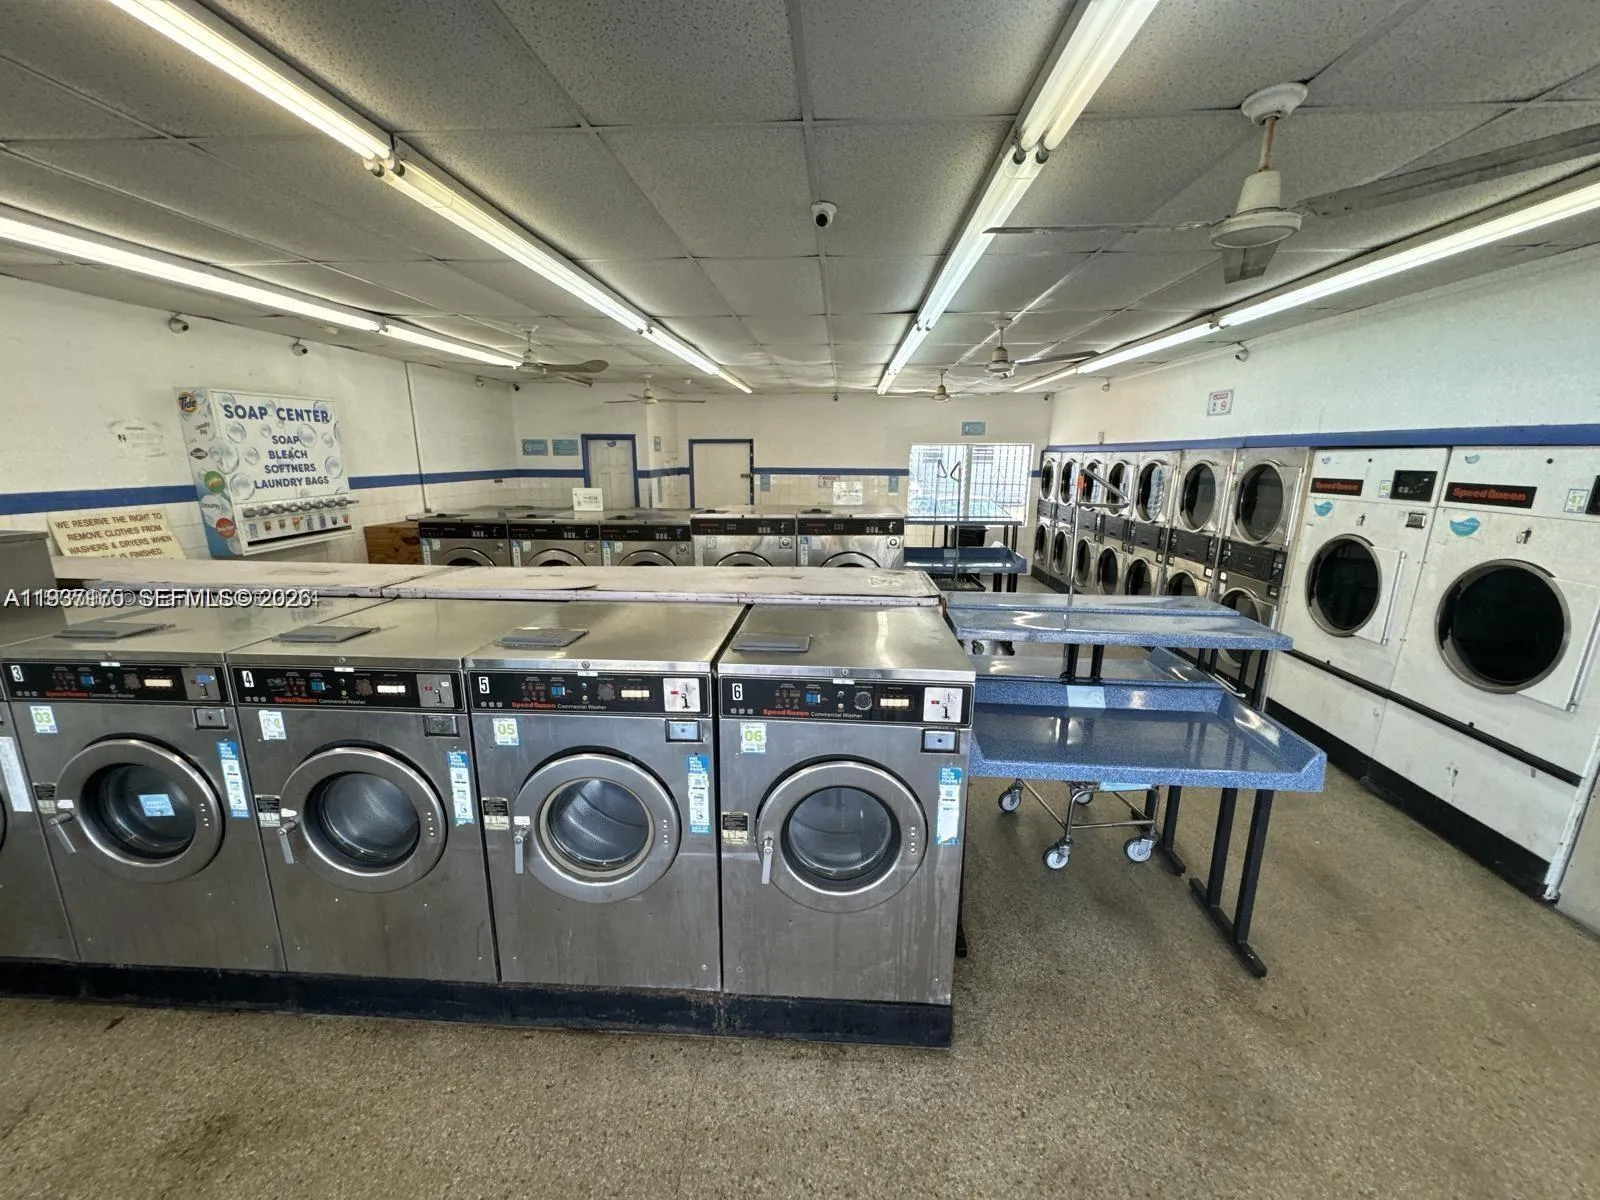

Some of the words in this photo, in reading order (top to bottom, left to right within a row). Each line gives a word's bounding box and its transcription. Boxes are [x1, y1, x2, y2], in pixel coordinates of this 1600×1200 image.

[223, 404, 268, 420] SOAP
[276, 407, 330, 423] CENTER
[271, 435, 300, 445] SOAP
[268, 449, 308, 460] BLEACH
[264, 463, 317, 474] SOFTNERS
[254, 478, 303, 490] LAUNDRY
[305, 475, 330, 486] BAGS
[1453, 487, 1487, 498] Speed
[1488, 488, 1527, 501] Queen
[54, 520, 70, 529] WE
[72, 517, 110, 528] RESERVE
[111, 515, 128, 524] THE
[128, 513, 151, 523] RIGHT
[152, 512, 162, 520] TO
[67, 531, 103, 542] REMOVE
[104, 526, 140, 538] CLOTHES
[141, 524, 162, 533] FROM
[67, 542, 109, 555] WASHERS
[111, 542, 117, 550] &
[119, 538, 150, 549] DRYERS
[150, 535, 172, 545] WHEN
[129, 548, 162, 559] FINISHED
[12, 666, 21, 681] 3
[244, 671, 252, 686] 4
[480, 677, 487, 692] 5
[734, 684, 741, 699] 6
[34, 711, 52, 724] 03
[498, 723, 515, 736] 05
[744, 730, 763, 742] 06
